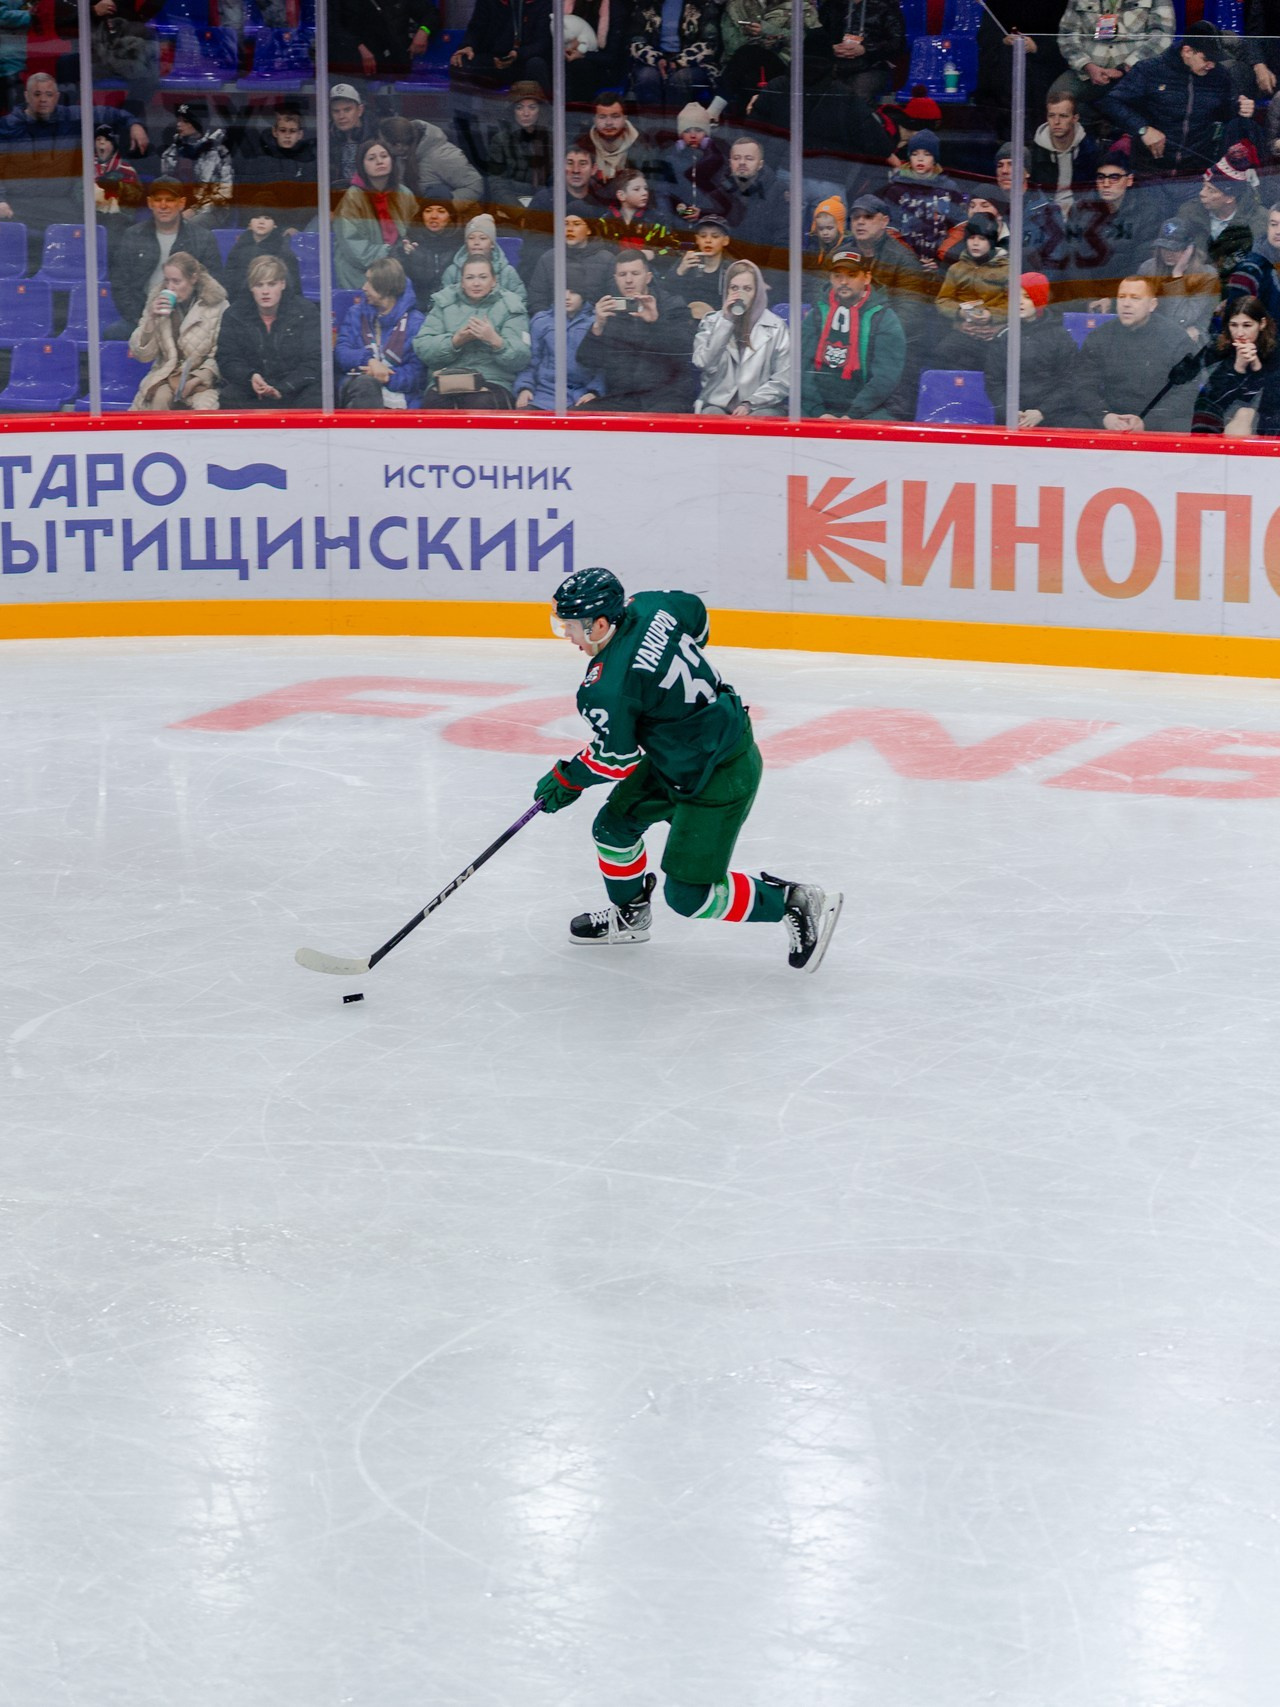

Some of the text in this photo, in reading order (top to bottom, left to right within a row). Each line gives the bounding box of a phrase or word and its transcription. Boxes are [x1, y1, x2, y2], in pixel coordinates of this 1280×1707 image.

[383, 464, 573, 490] ИСТОЧНИК
[787, 475, 1280, 604] КИНОП
[632, 609, 678, 673] YAKUPOV
